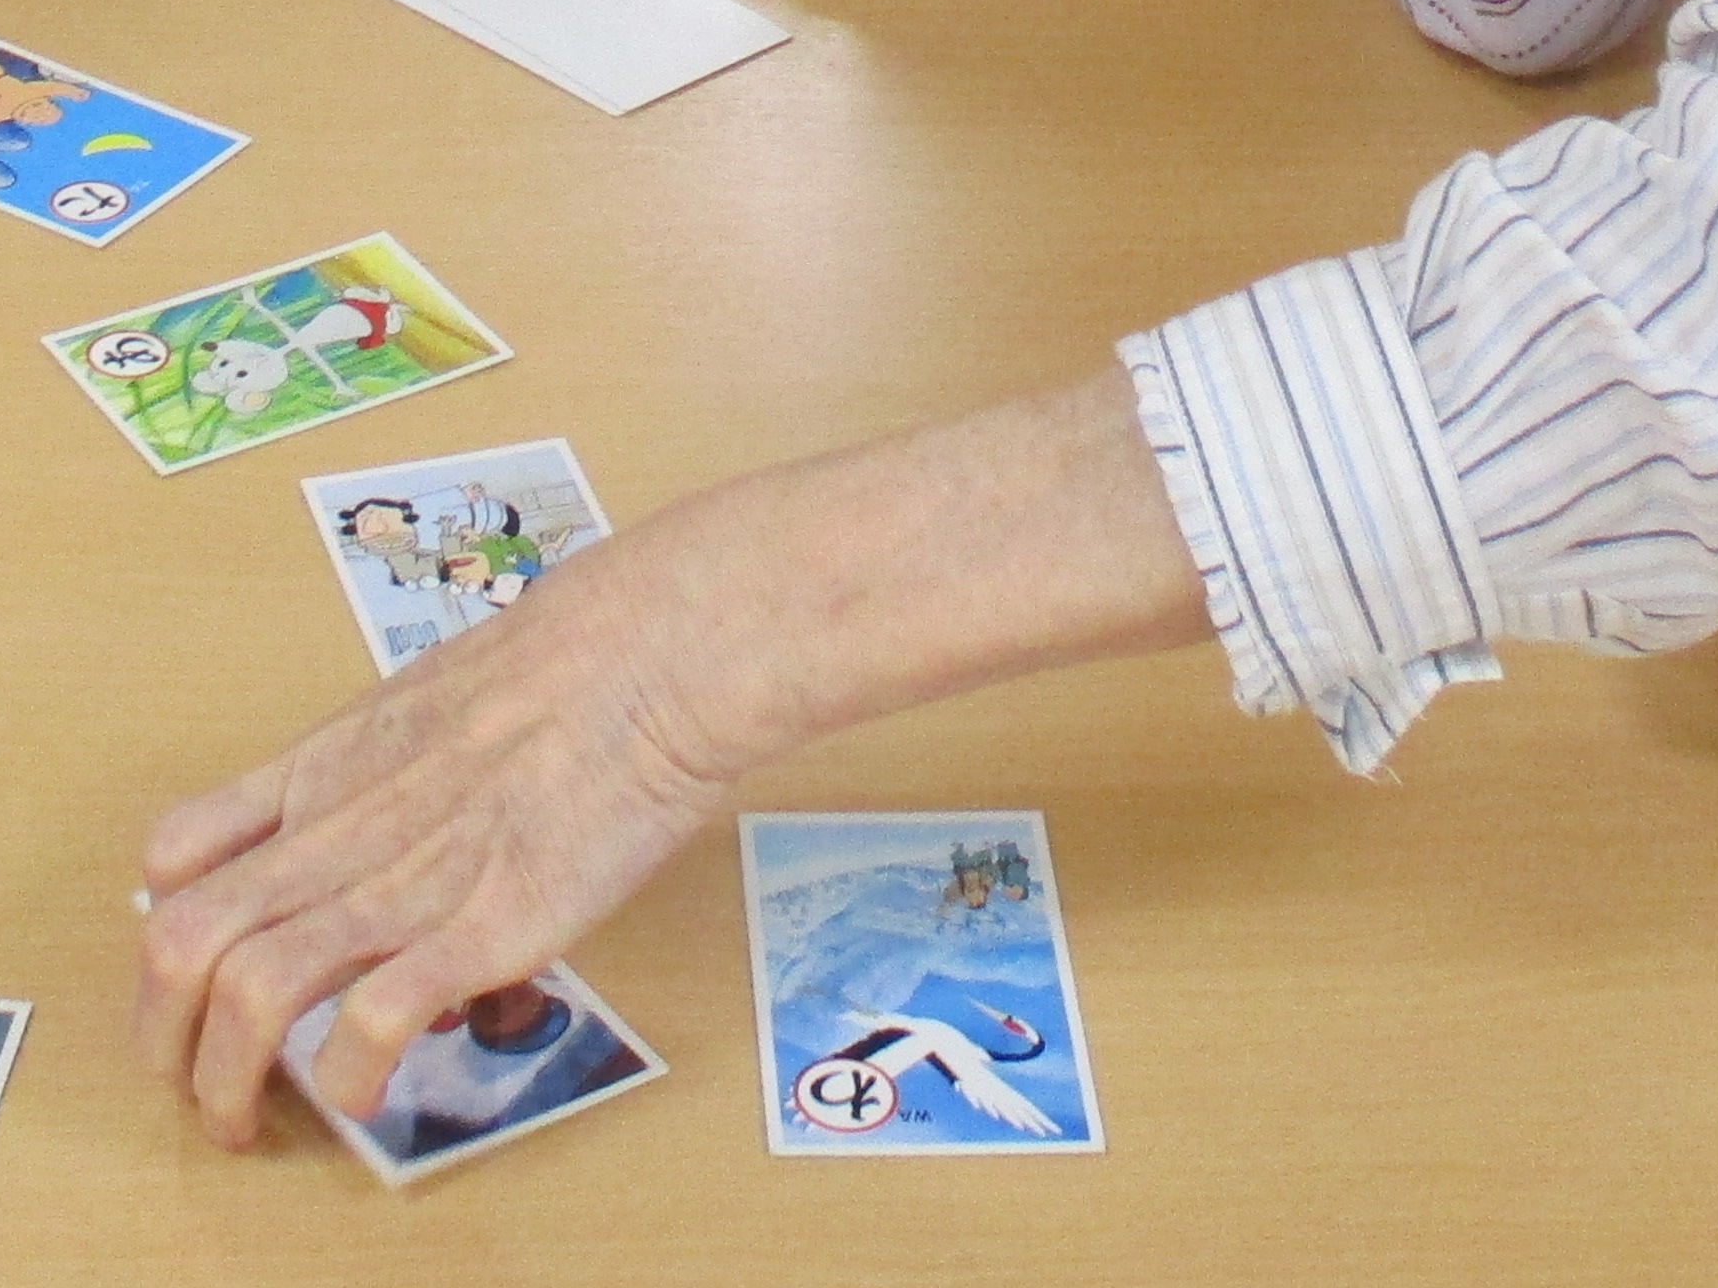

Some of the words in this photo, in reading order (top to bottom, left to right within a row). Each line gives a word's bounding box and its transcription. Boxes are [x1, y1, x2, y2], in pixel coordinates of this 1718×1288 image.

[57, 186, 120, 218] た
[102, 336, 161, 370] あ
[809, 1069, 881, 1122] わ
[899, 1108, 933, 1124] WA
